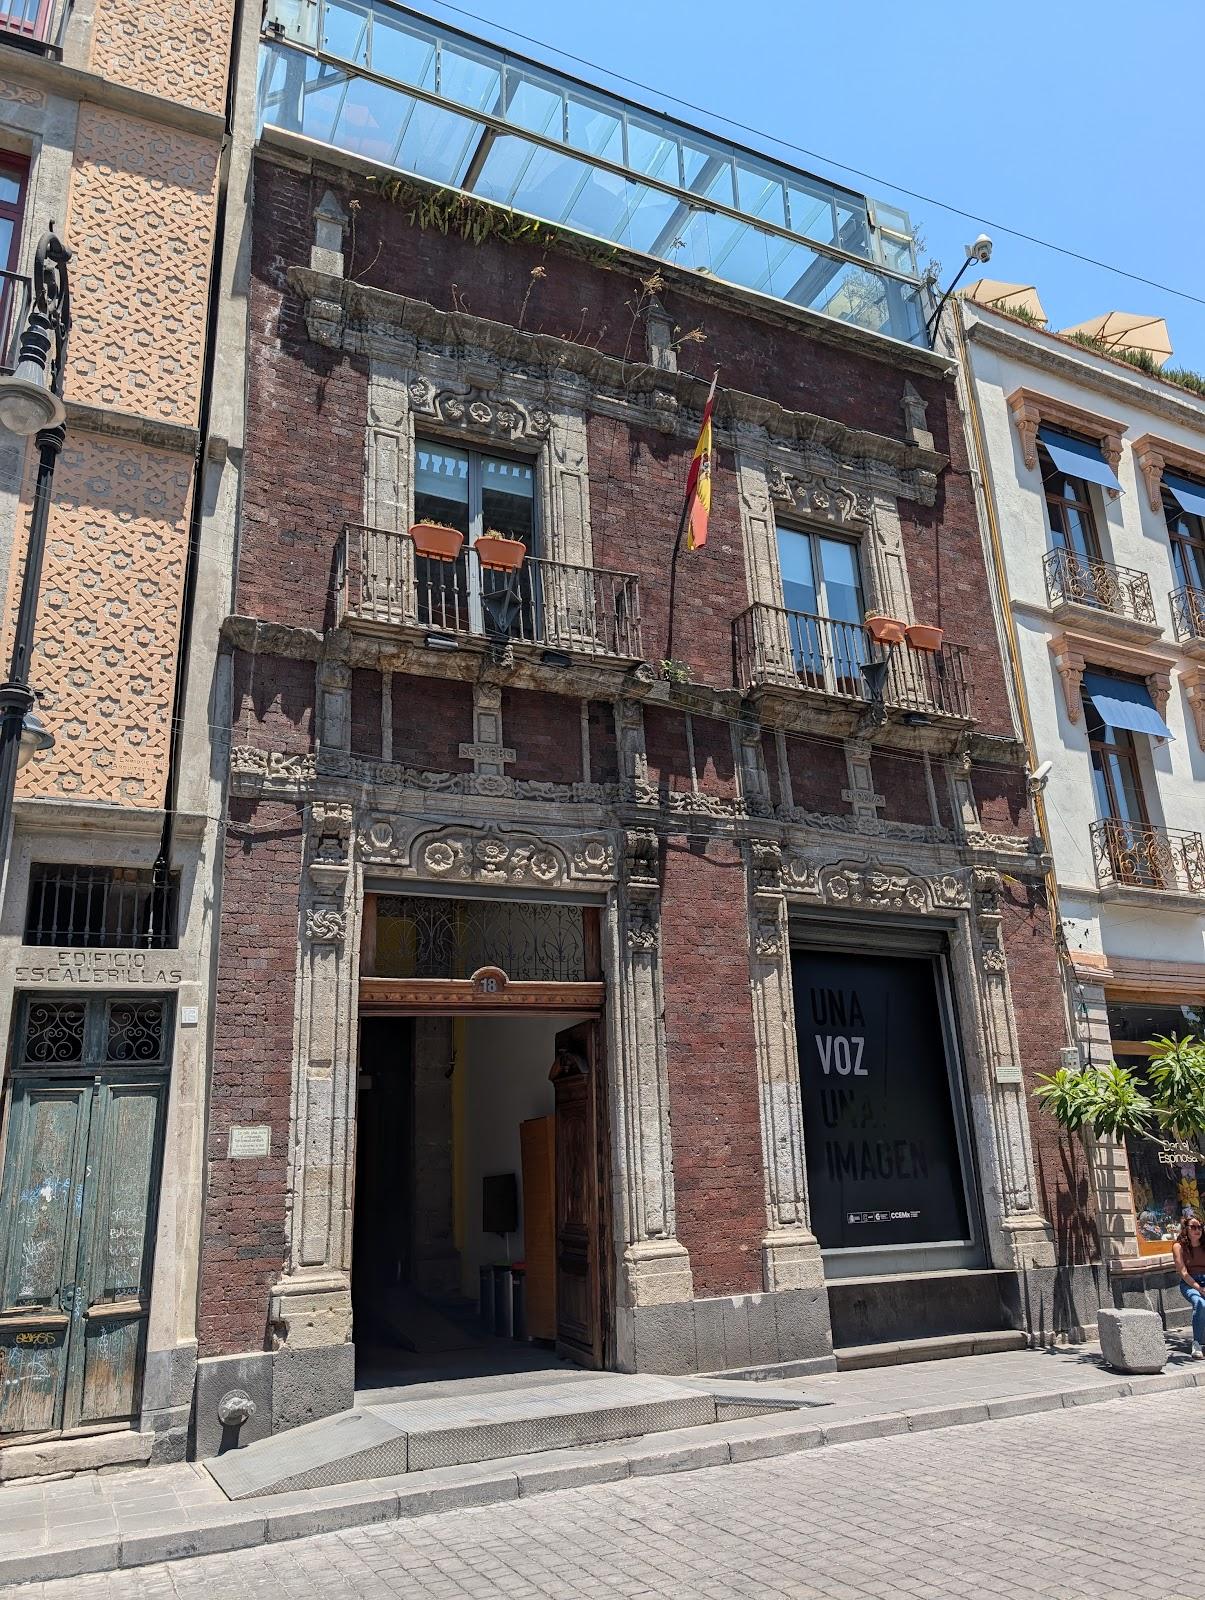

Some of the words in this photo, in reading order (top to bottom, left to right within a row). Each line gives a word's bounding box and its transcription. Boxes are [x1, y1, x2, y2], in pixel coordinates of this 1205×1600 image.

[58, 952, 146, 968] EDIFICIO
[15, 967, 182, 984] ESCALERILLAS
[481, 978, 497, 993] 18
[811, 987, 865, 1027] UNA
[815, 1034, 869, 1076] VOZ
[825, 1140, 929, 1182] IMAGEN
[1158, 1151, 1198, 1168] Espinosa
